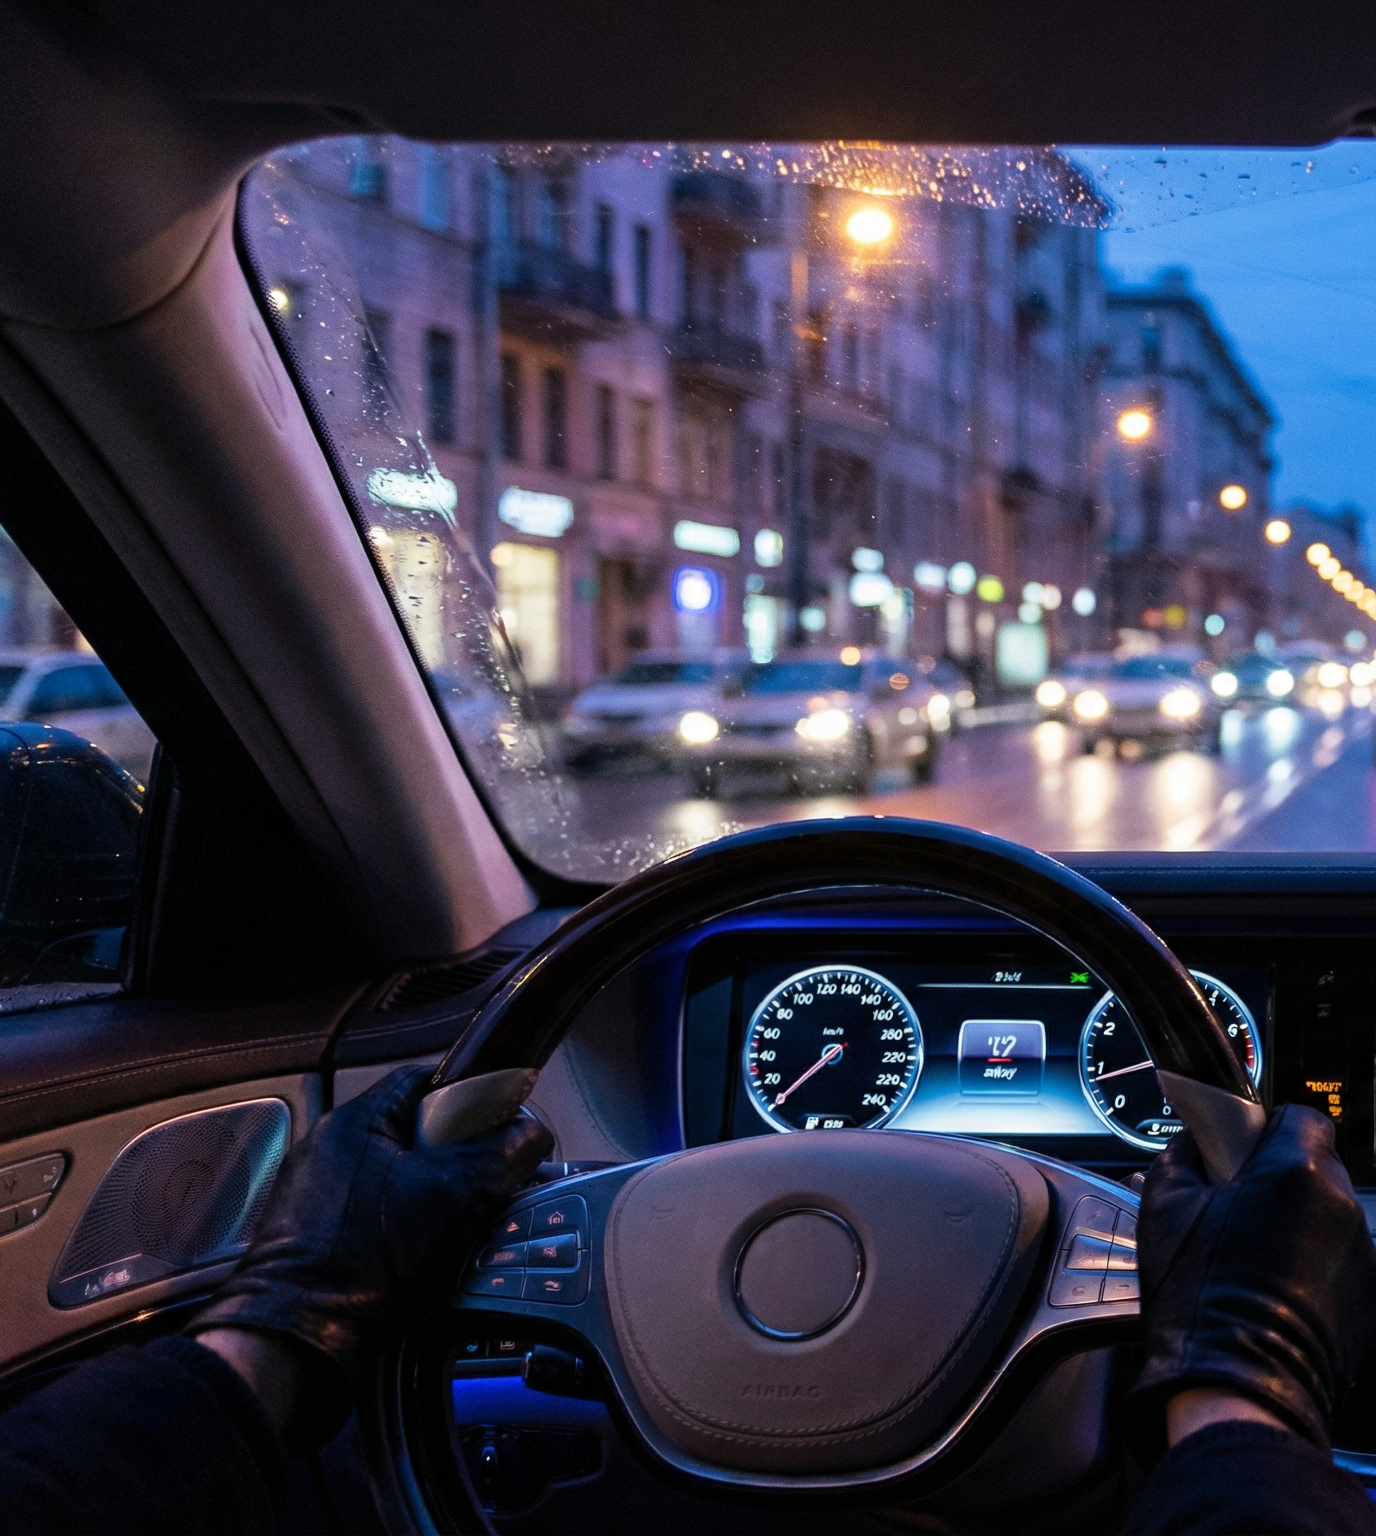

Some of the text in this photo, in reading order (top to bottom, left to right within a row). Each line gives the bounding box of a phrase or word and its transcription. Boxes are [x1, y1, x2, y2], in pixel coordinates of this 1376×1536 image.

[817, 983, 837, 995] 120
[793, 993, 814, 1005] 100
[777, 1008, 793, 1020] 80
[763, 1028, 781, 1040] 60
[1103, 1022, 1116, 1036] 2
[759, 1050, 777, 1062] 40
[881, 1052, 906, 1063] 220
[1097, 1061, 1105, 1075] 1
[764, 1073, 781, 1085] 20
[876, 1074, 901, 1086] 220
[862, 1093, 886, 1106] 240
[1114, 1094, 1126, 1109] 0
